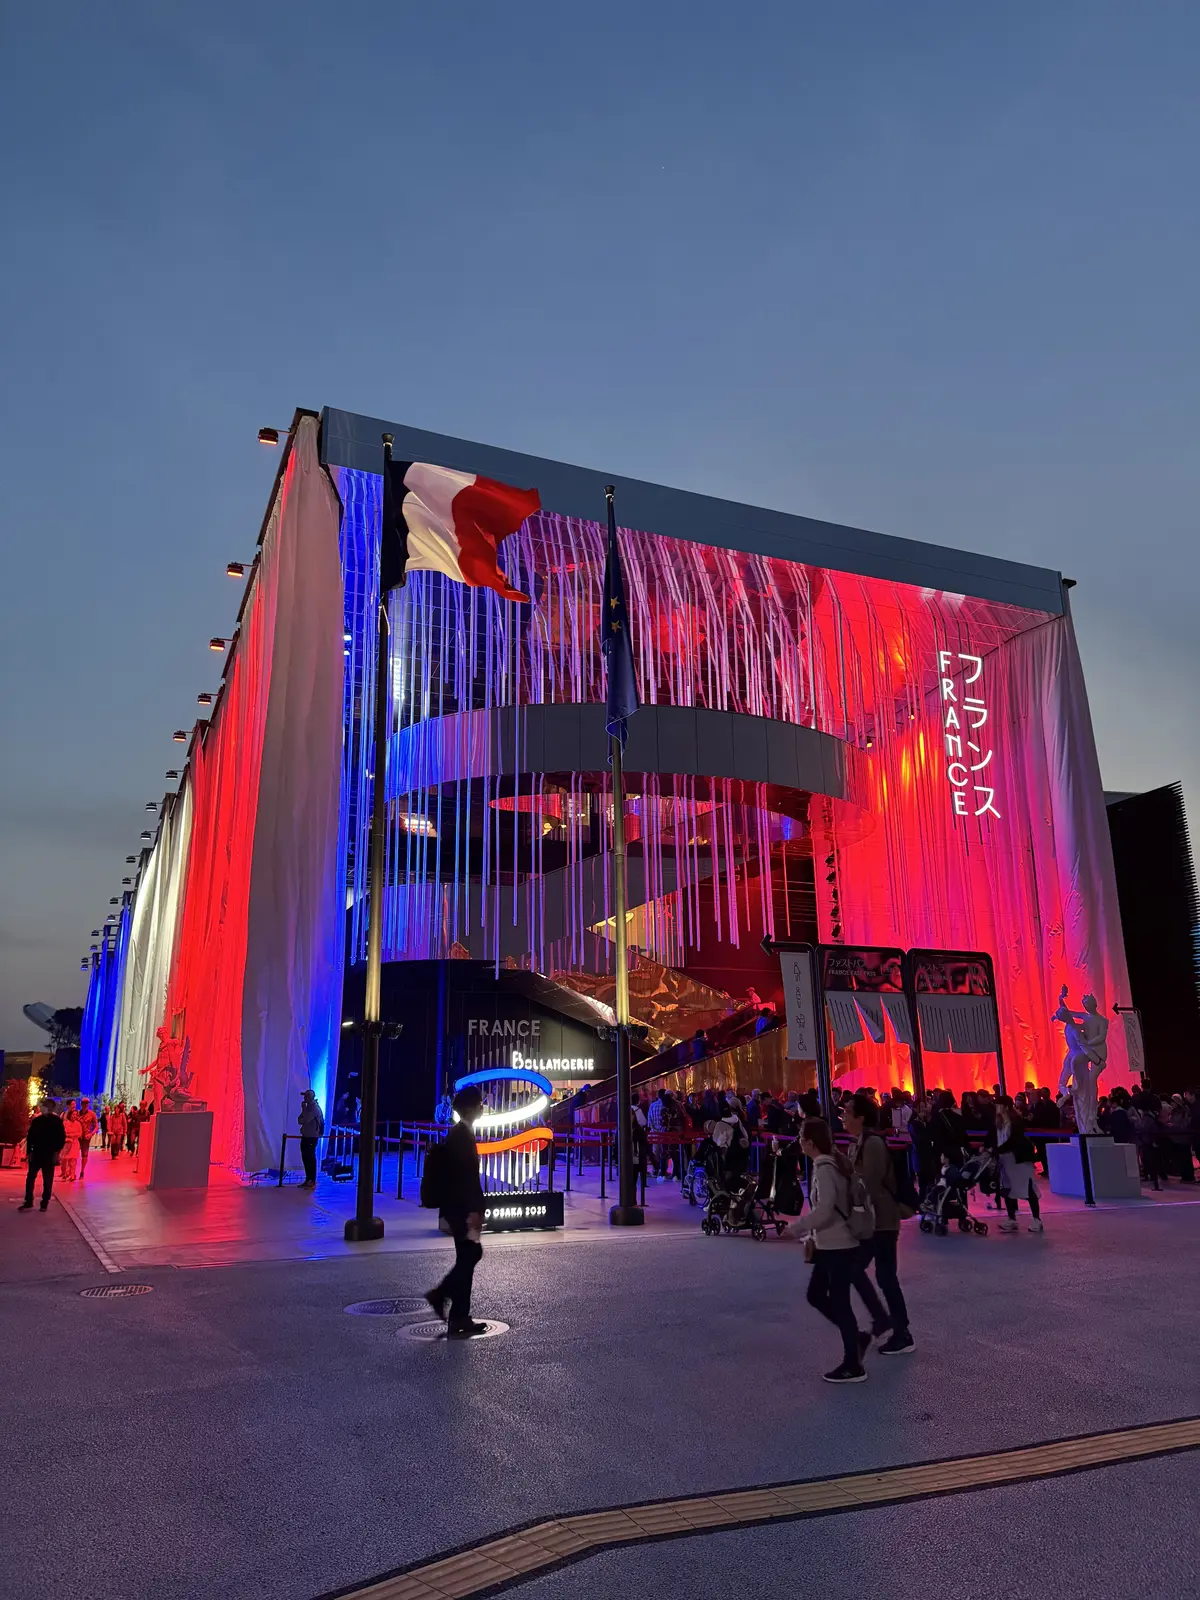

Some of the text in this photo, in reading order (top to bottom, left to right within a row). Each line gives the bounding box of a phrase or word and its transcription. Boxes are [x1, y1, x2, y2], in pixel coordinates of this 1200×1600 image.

[939, 651, 969, 815] FRANCE
[957, 653, 1001, 819] フランス
[468, 1019, 540, 1036] FRANCE
[492, 1207, 523, 1218] OSAKA
[525, 1205, 546, 1216] 2025
